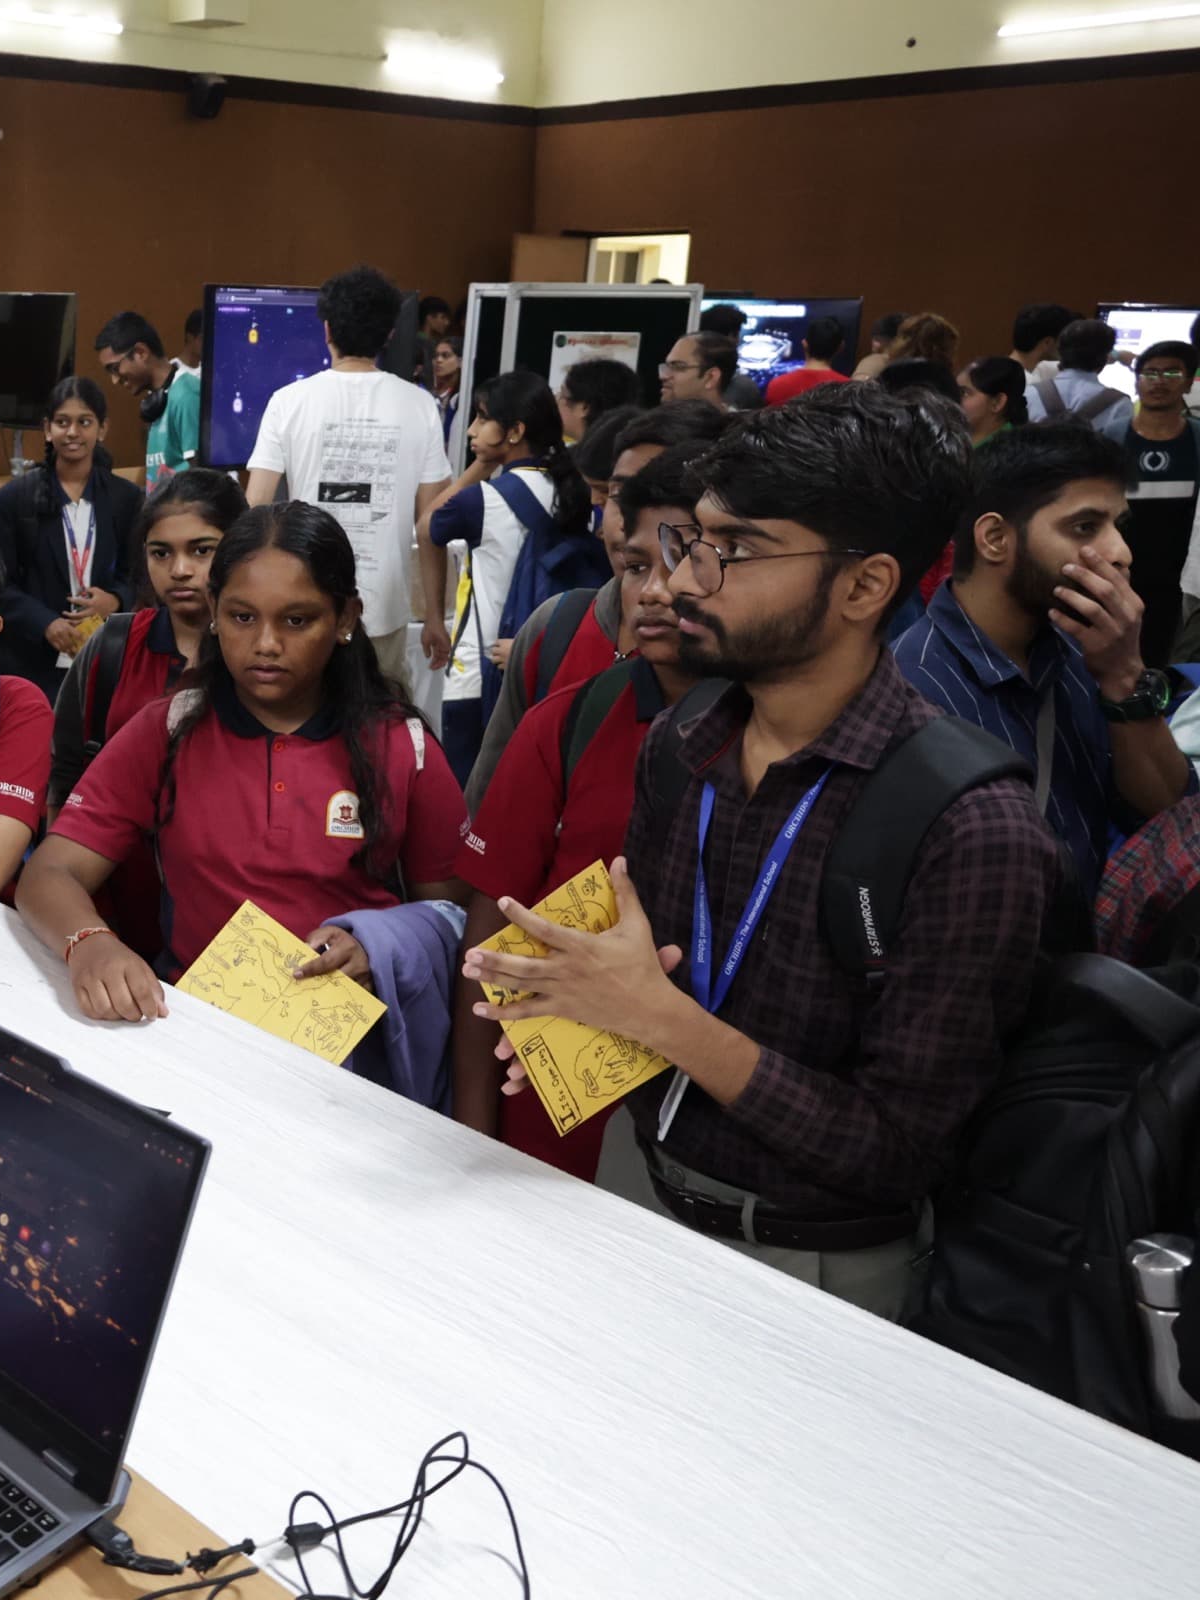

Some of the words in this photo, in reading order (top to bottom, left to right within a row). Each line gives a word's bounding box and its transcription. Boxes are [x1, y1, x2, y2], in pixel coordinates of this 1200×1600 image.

[784, 801, 809, 839] ORCHIDS
[724, 940, 743, 976] ORCHIDS
[740, 923, 750, 937] The
[748, 884, 767, 926] International
[764, 861, 778, 886] School
[859, 886, 880, 947] STAYWROGN
[697, 938, 706, 963] School
